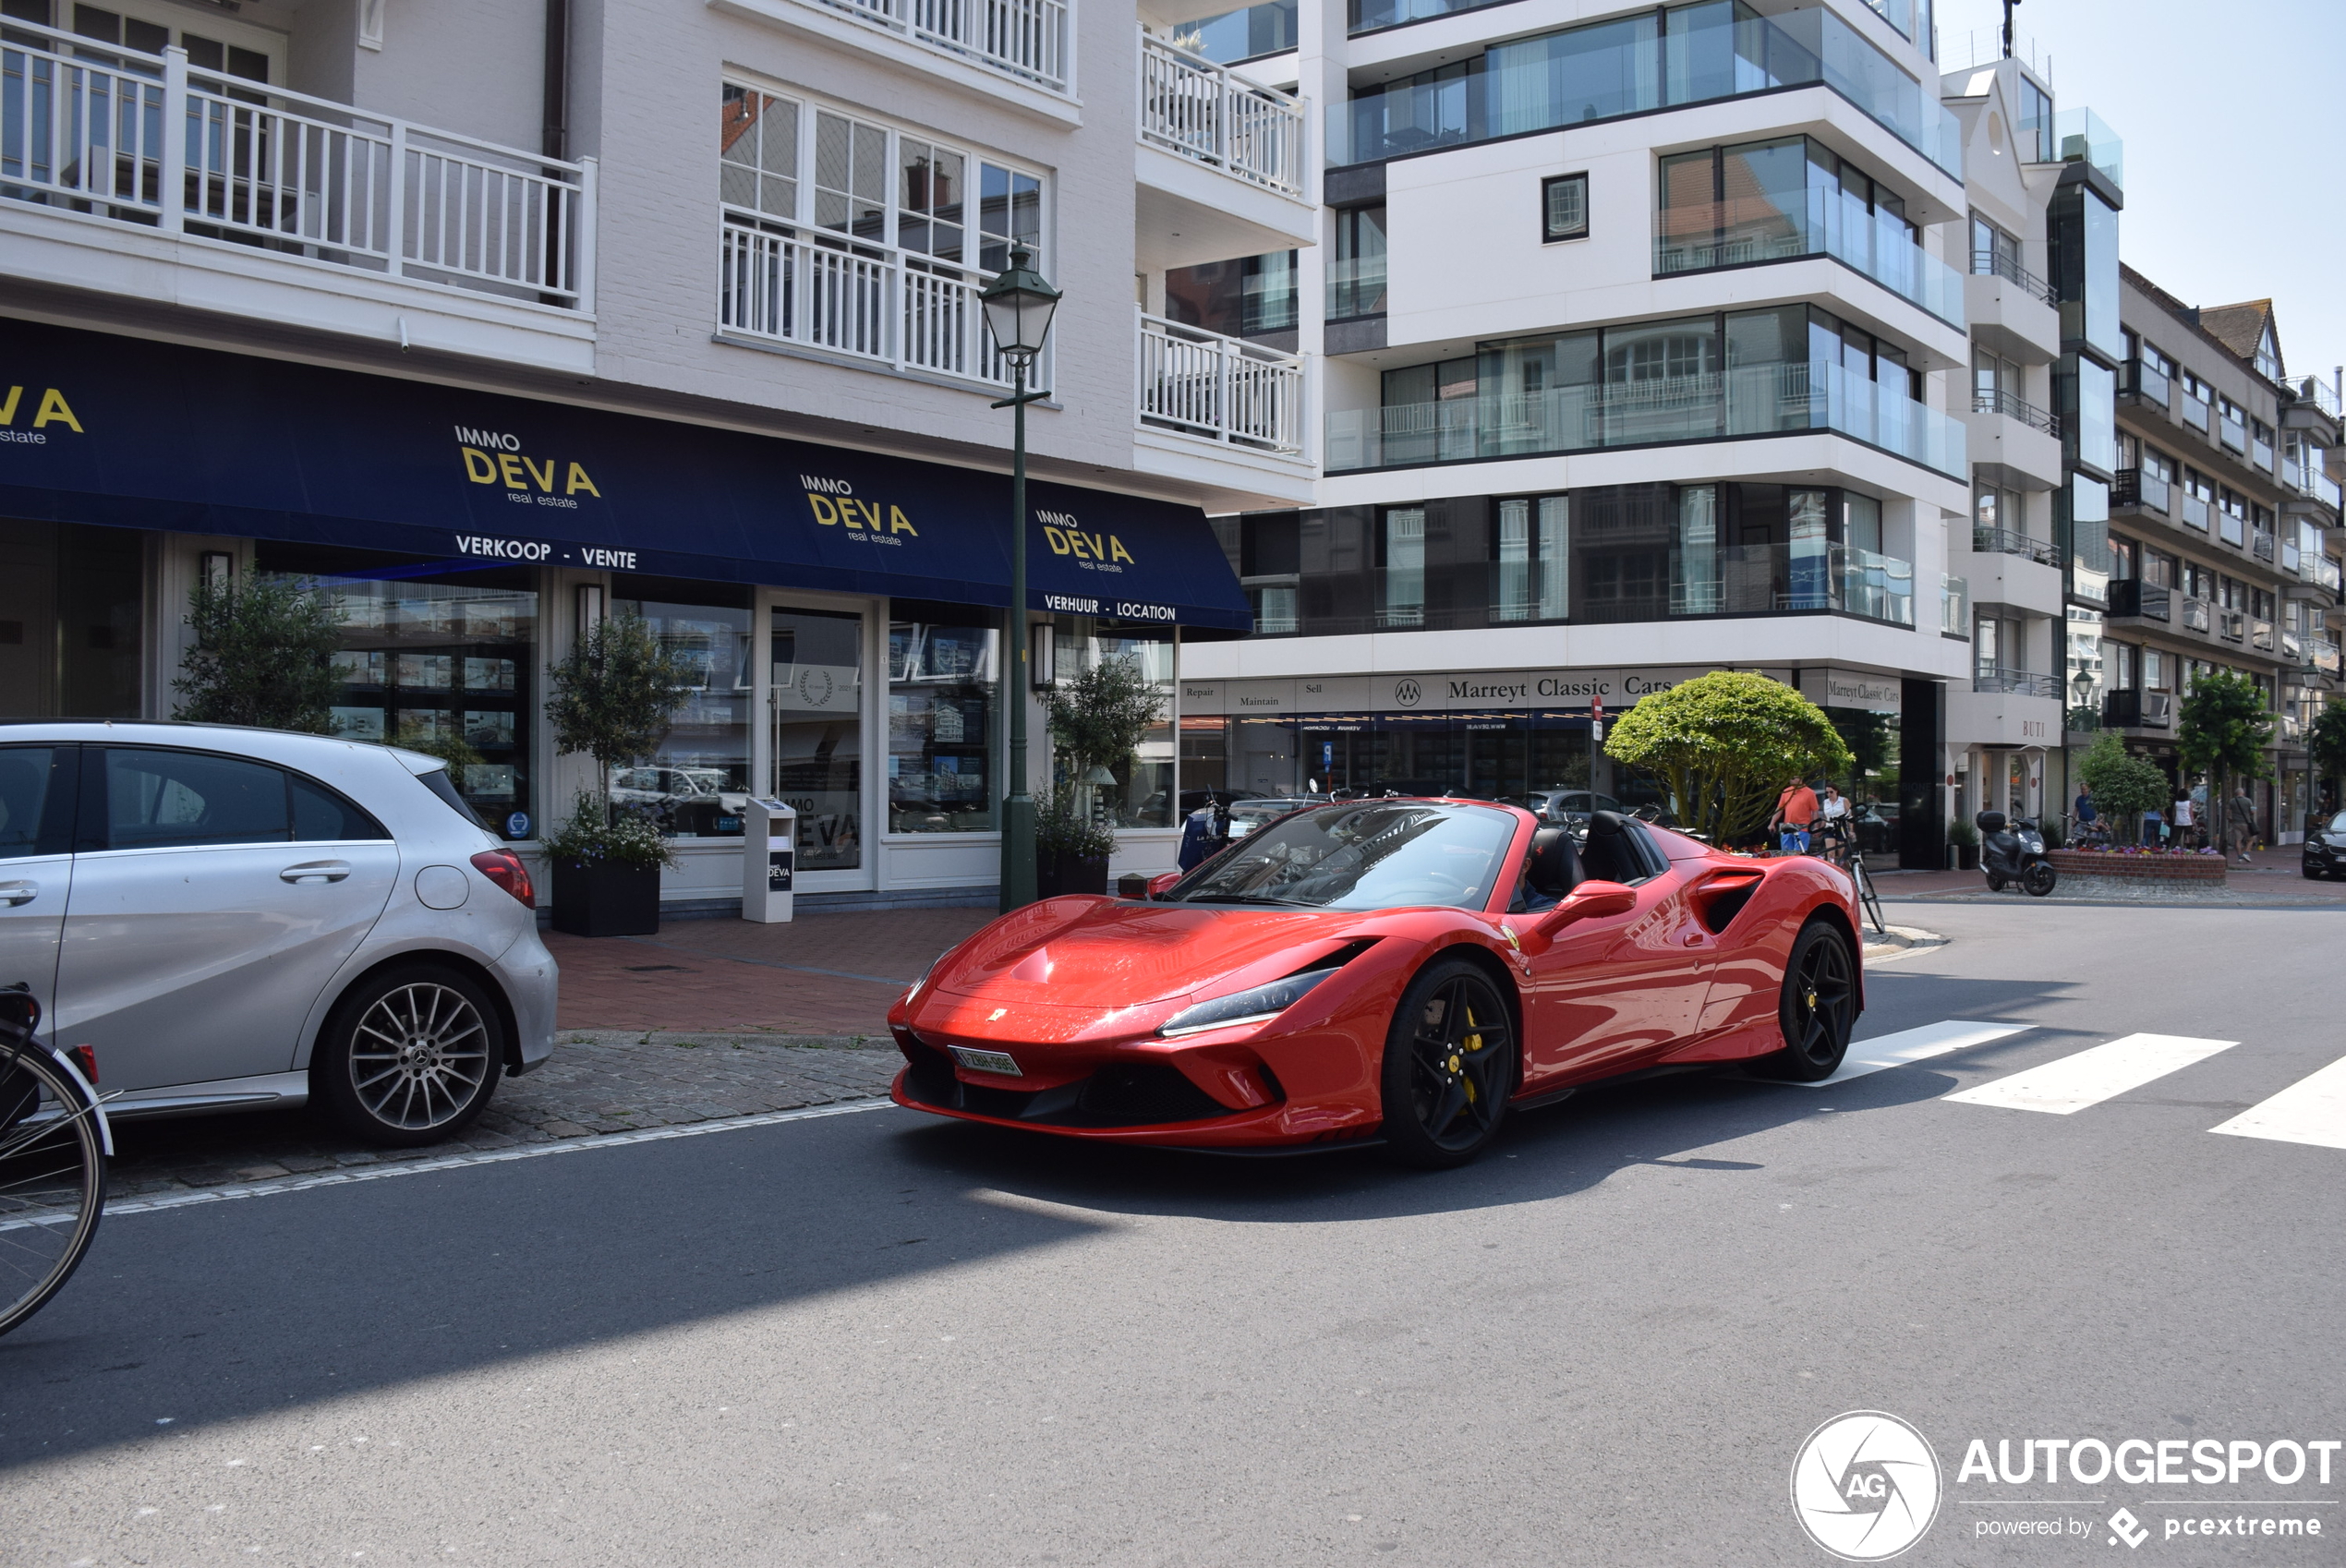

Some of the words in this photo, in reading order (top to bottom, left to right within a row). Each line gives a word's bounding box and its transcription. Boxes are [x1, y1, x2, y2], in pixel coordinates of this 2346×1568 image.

[454, 425, 521, 452] IMMO
[462, 446, 601, 498] DEVA
[800, 474, 853, 495] IMMO
[507, 492, 533, 504] real
[538, 496, 578, 509] estate
[807, 493, 919, 537] DEVA
[1035, 509, 1078, 528] IMMO
[847, 532, 868, 542] real
[871, 534, 902, 546] estate
[1044, 526, 1135, 564] DEVA
[455, 535, 551, 561] VERKOOP
[582, 548, 636, 569] VENTE
[1079, 561, 1094, 570] real
[1096, 562, 1123, 573] estate
[1045, 595, 1098, 614] VERHUUR
[1117, 602, 1176, 621] LOCATION
[1187, 688, 1214, 699] Repair
[1306, 684, 1322, 693] Sell
[1448, 681, 1527, 703] Marreyt
[1537, 678, 1610, 696] Classic
[1625, 676, 1672, 694] Cars
[1829, 681, 1857, 702] Marreyt
[1858, 683, 1882, 701] Classic
[1884, 687, 1899, 702] Cars
[1240, 697, 1279, 706] Maintain
[2023, 720, 2045, 738] BUTI
[797, 814, 860, 847] EVA
[768, 868, 790, 876] DEVA
